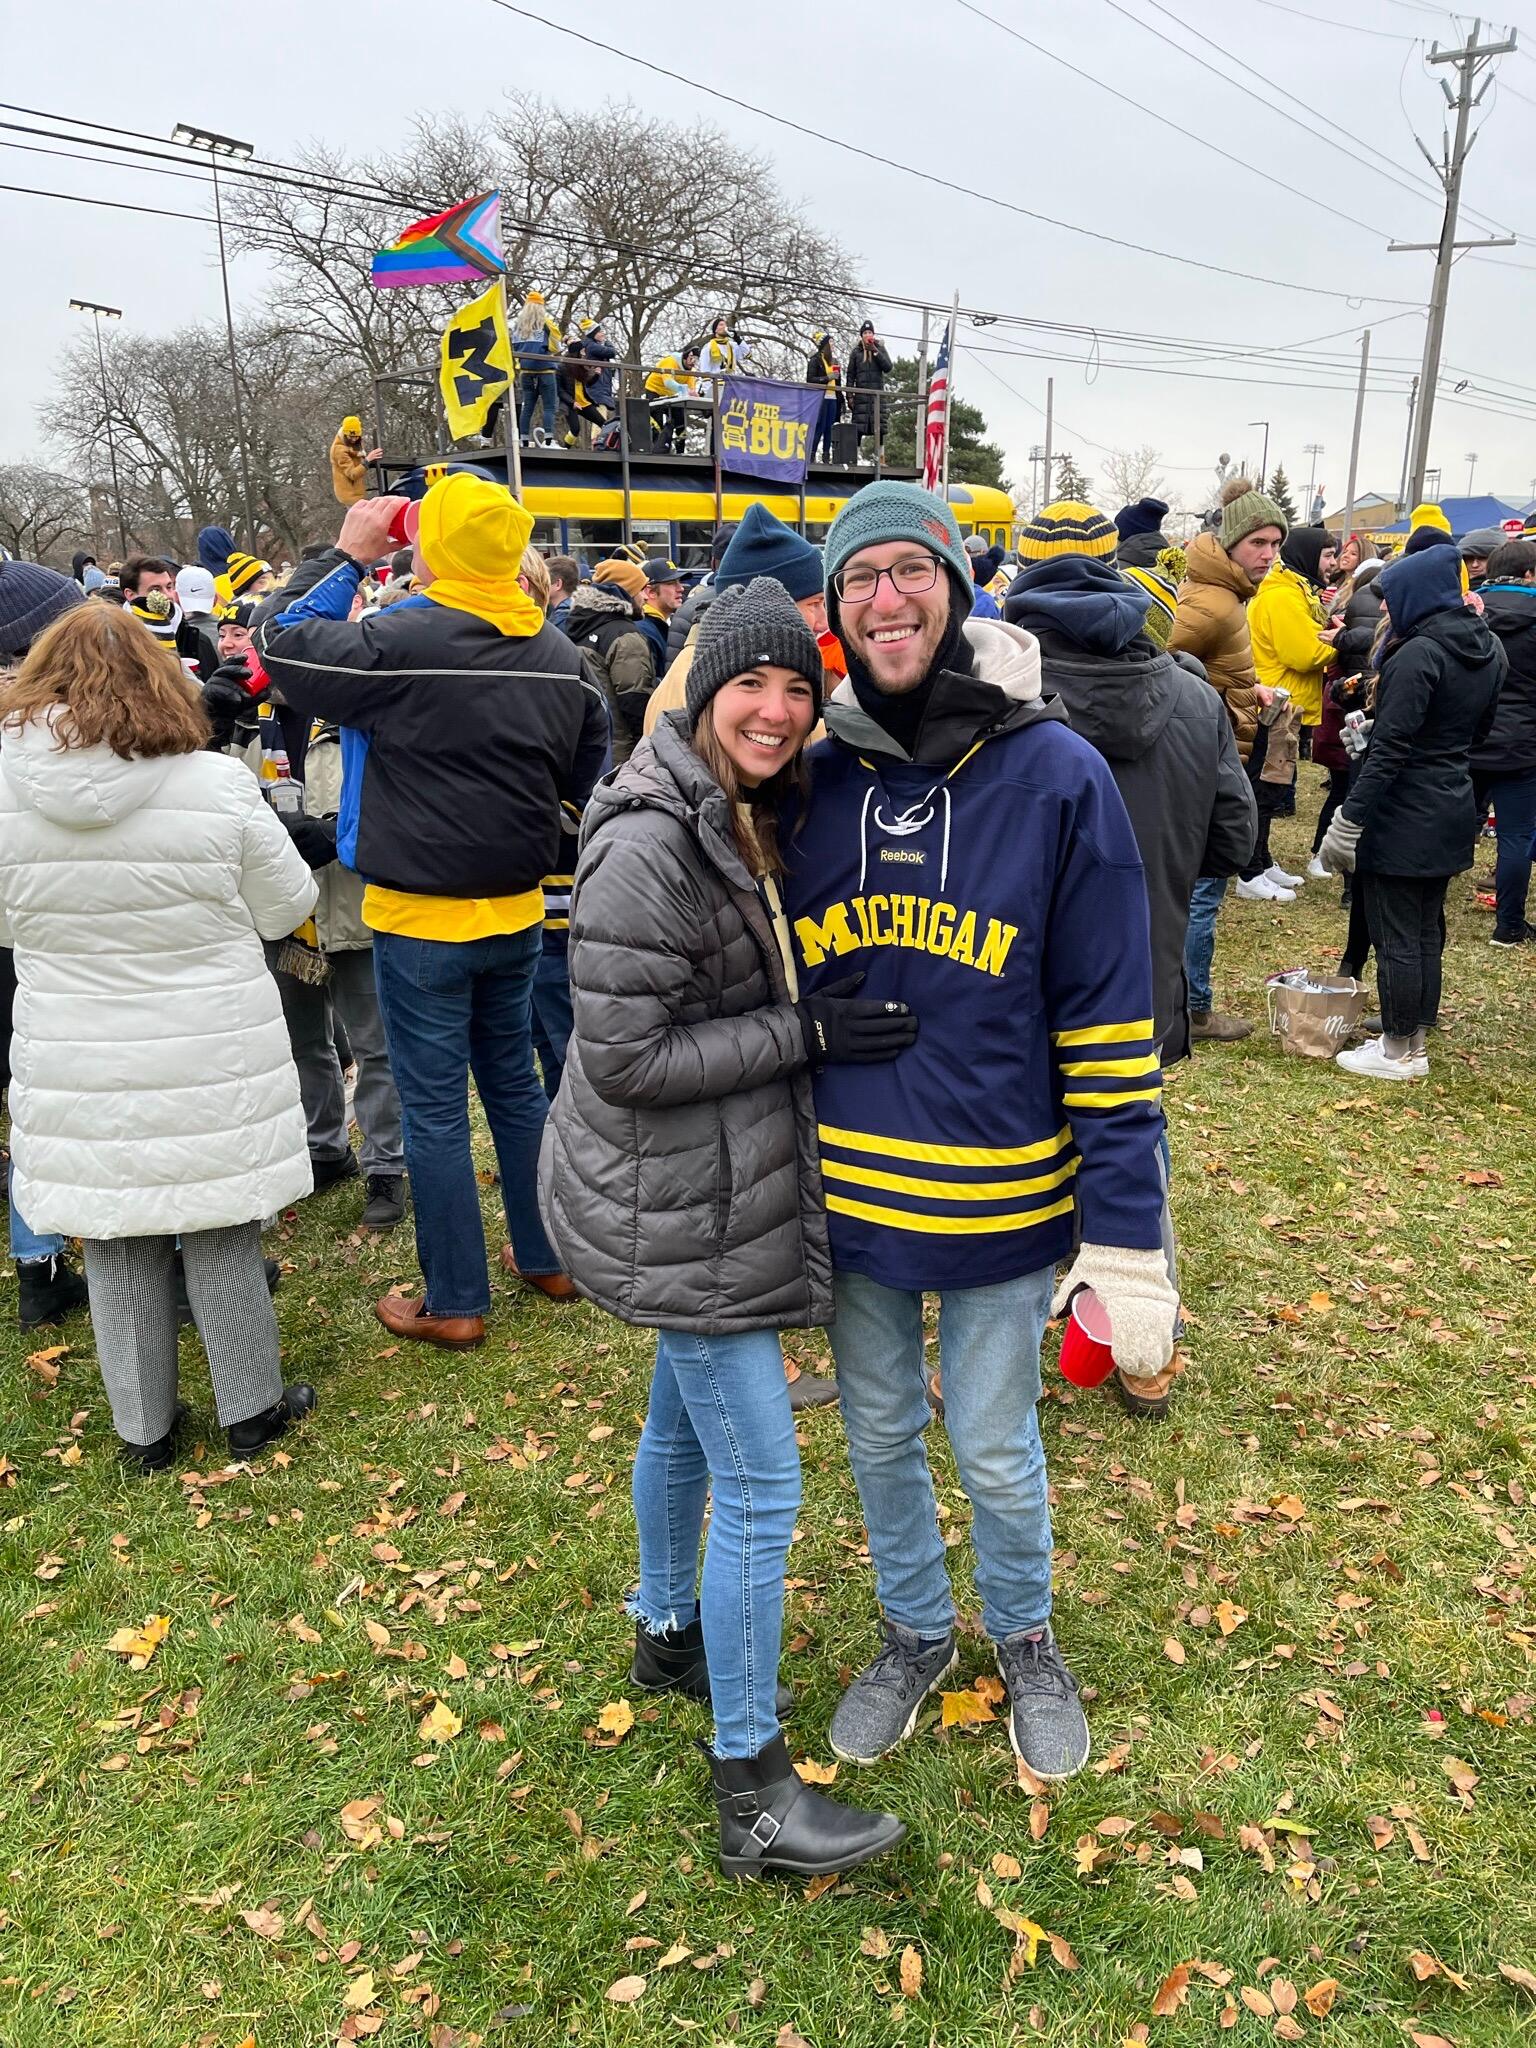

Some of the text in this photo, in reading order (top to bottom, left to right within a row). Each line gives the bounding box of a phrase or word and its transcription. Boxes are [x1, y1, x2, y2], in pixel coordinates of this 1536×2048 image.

[448, 316, 508, 407] M
[753, 403, 780, 419] THE
[749, 417, 808, 460] BUS
[219, 606, 239, 620] M
[880, 850, 925, 864] Reebok
[794, 894, 1018, 977] MICHIGAN
[816, 1021, 828, 1051] HEAD
